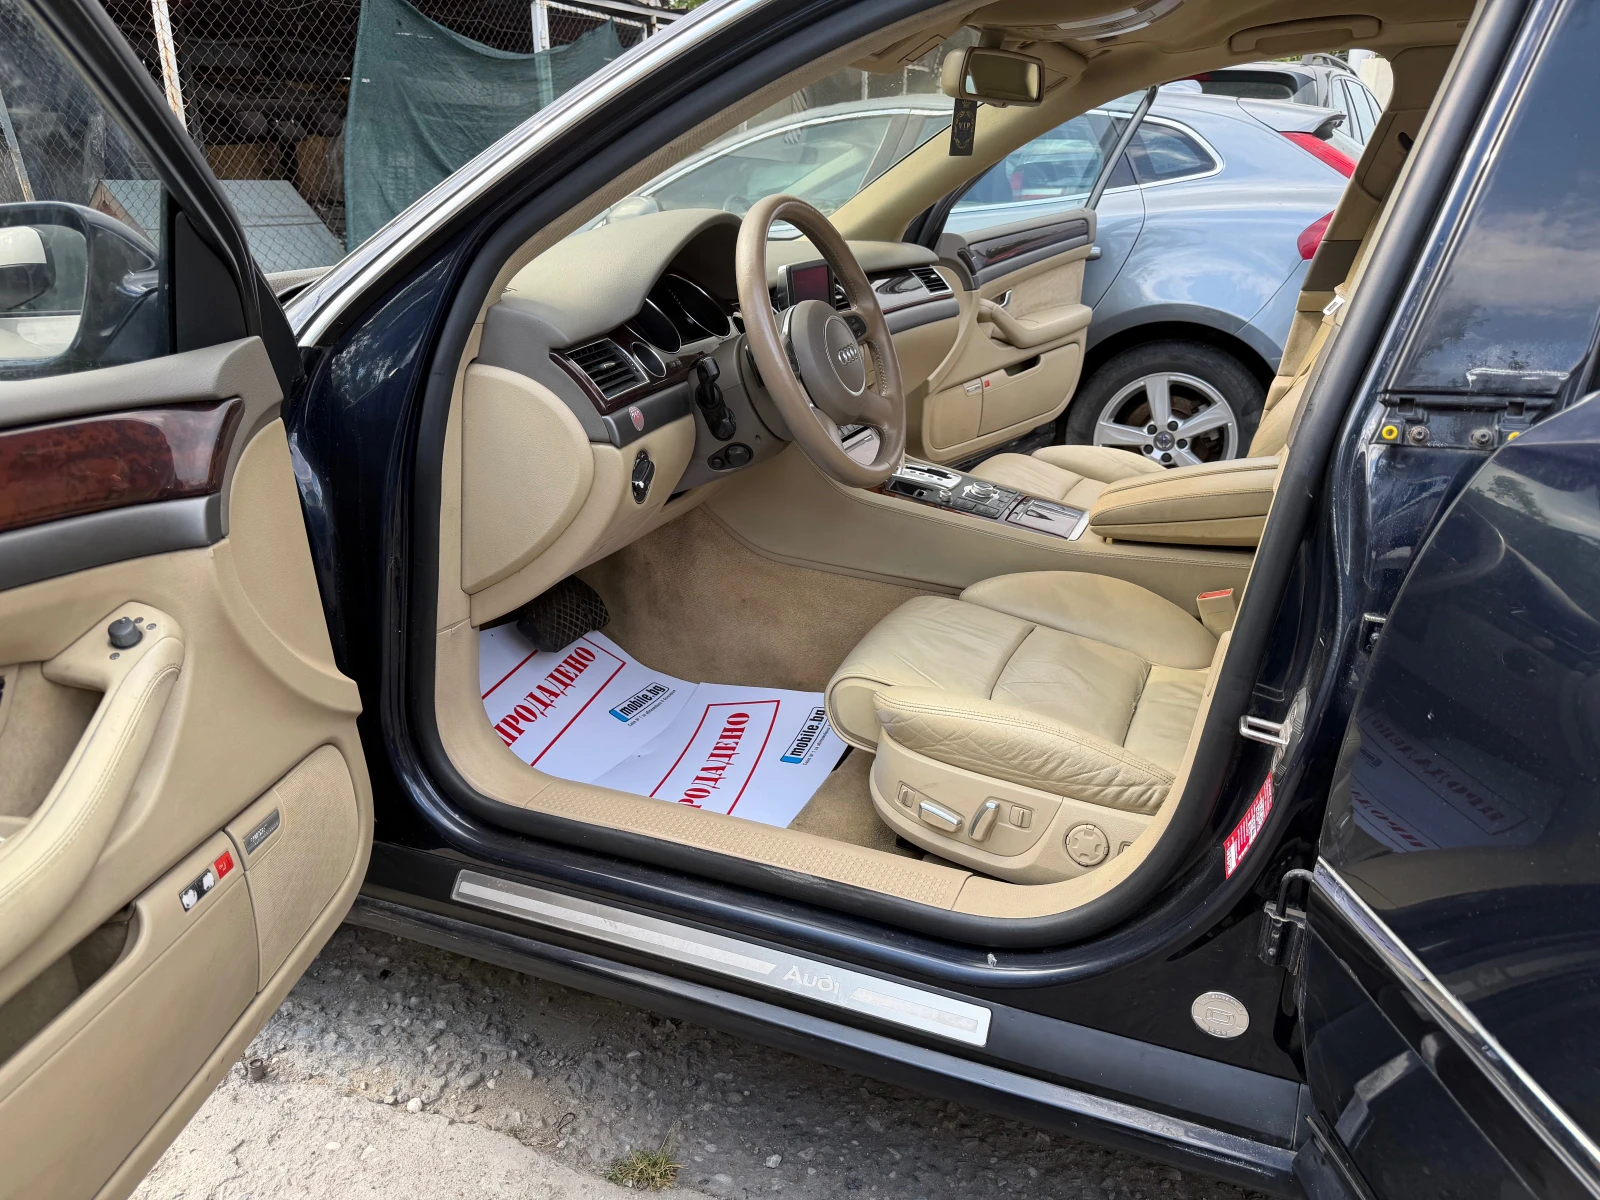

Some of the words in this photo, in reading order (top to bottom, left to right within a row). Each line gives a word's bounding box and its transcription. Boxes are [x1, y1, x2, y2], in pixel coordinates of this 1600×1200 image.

[958, 122, 971, 130] VIP
[494, 646, 596, 748] ПРОДАДЕНО
[619, 685, 666, 717] mobile.bg
[678, 712, 750, 809] РОДАДЕНО
[783, 965, 840, 993] Audi
